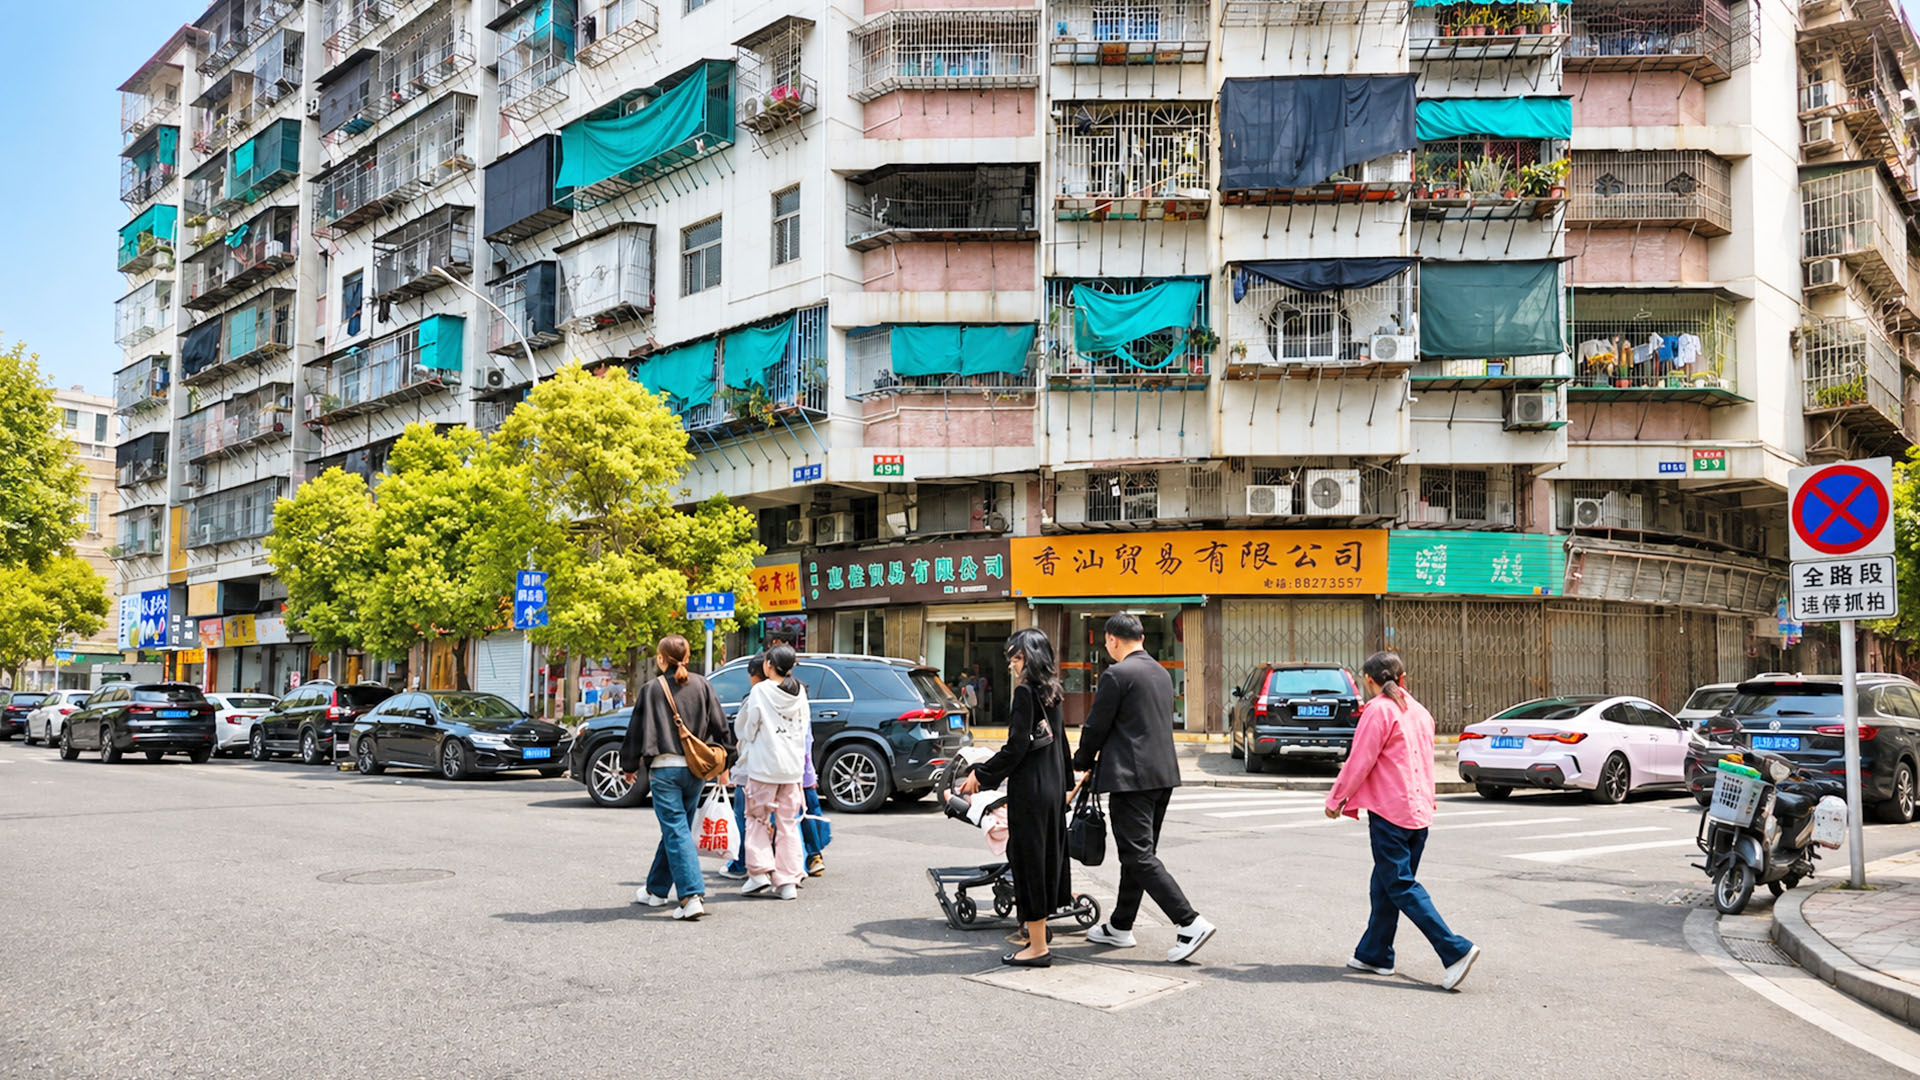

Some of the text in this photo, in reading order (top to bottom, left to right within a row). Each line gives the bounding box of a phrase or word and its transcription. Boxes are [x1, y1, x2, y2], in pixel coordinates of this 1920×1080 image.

[1033, 541, 1363, 576] 香汕贸易有限公司
[1802, 562, 1884, 588] 全路段
[1801, 591, 1885, 614] 违停抓拍
